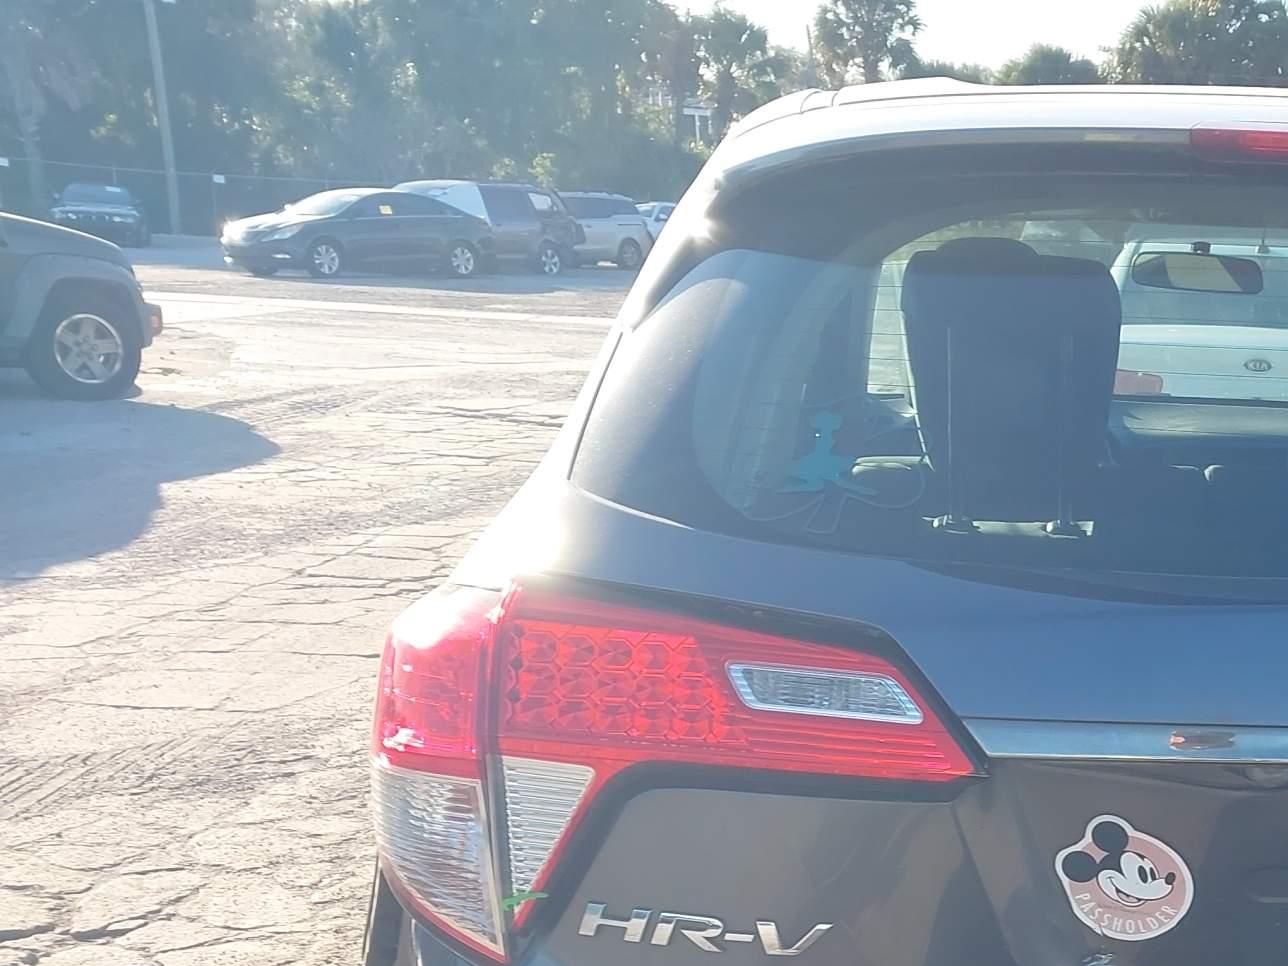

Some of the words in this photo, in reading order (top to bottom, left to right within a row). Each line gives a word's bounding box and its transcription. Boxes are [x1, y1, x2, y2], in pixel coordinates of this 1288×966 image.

[1247, 360, 1269, 371] KIA
[577, 902, 835, 956] HR-V
[1073, 891, 1180, 935] PASSHOLDER
